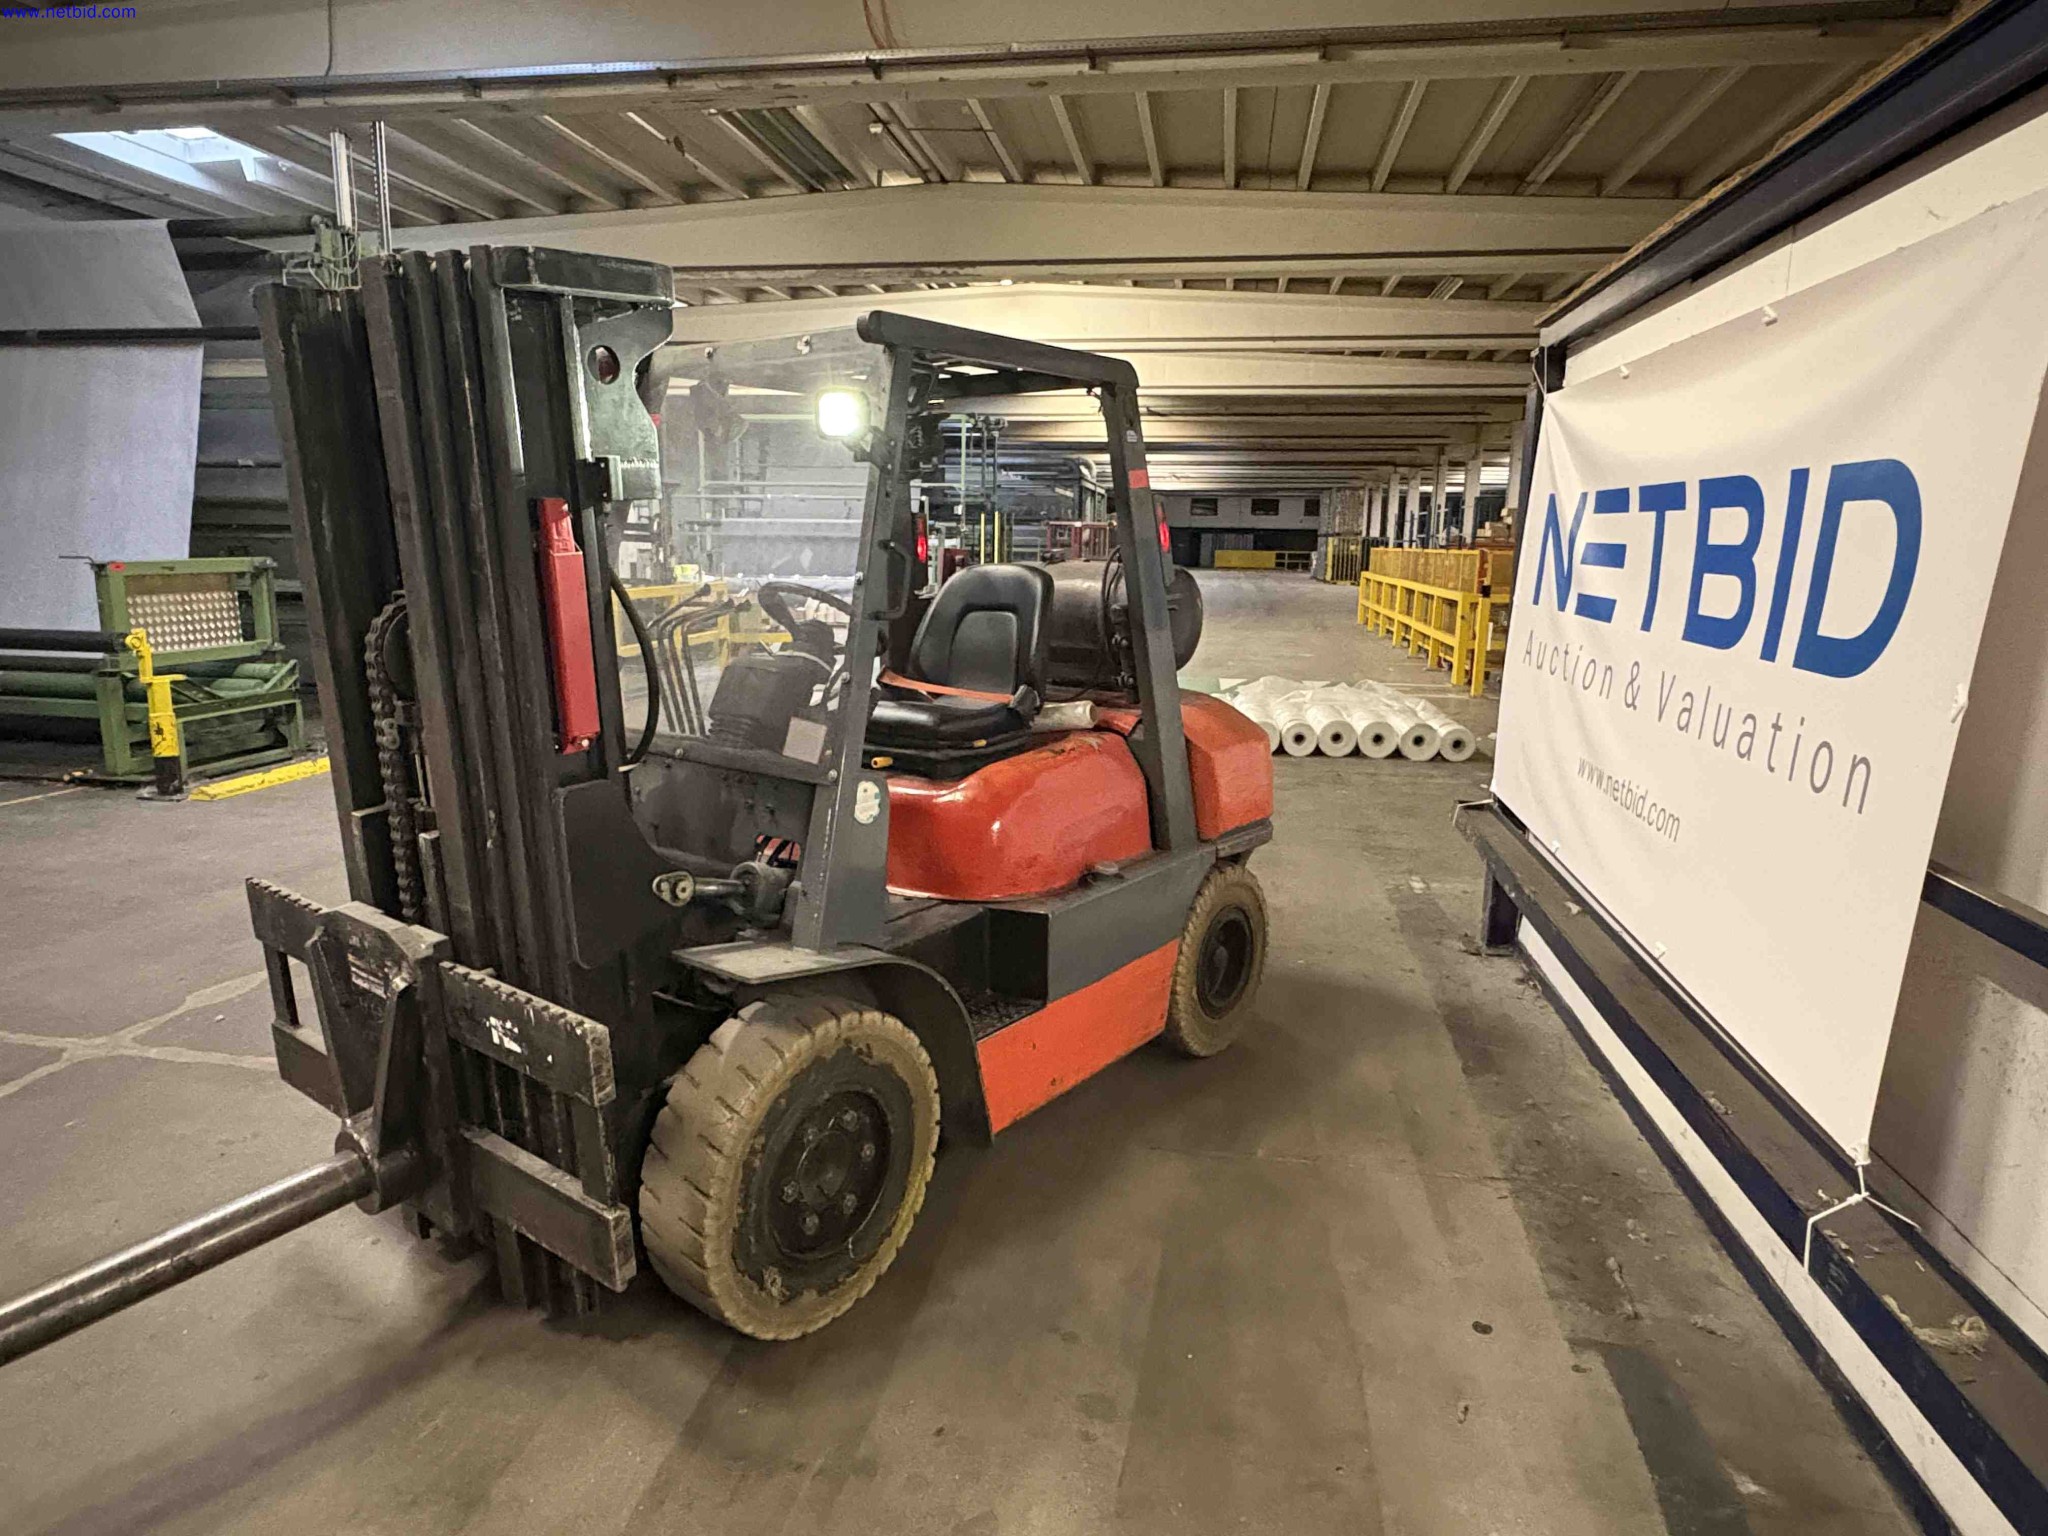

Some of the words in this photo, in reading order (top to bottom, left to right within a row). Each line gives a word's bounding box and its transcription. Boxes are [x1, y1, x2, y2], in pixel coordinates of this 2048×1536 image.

[1532, 458, 1922, 678] NETBID
[1522, 629, 1614, 701] Auction
[1623, 660, 1642, 711] &
[1657, 670, 1872, 815] Valuation
[1577, 756, 1681, 843] www.netbid.com
